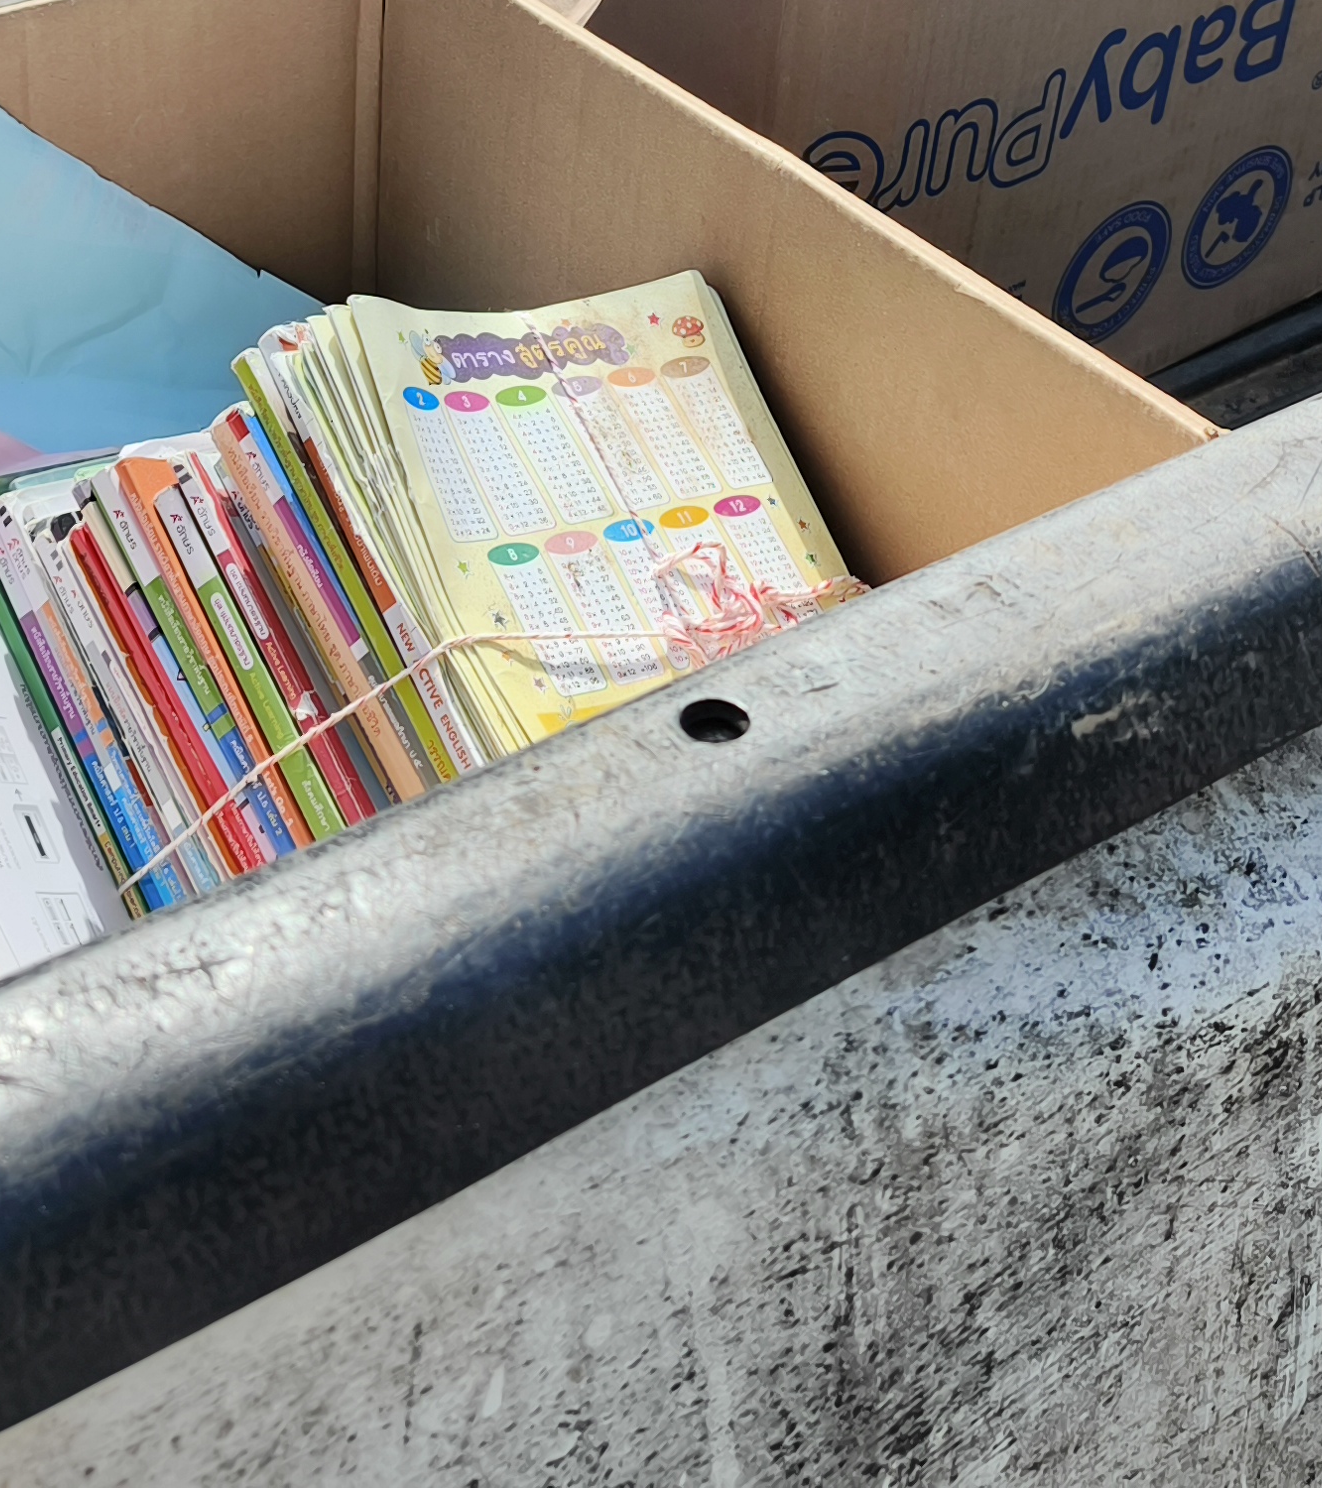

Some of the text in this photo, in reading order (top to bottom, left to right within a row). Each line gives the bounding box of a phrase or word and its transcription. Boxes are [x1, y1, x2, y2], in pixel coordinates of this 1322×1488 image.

[416, 392, 427, 406] 2
[461, 393, 472, 409] 3
[517, 390, 527, 402] 4
[627, 371, 636, 384] 6
[679, 362, 688, 373] 7
[196, 505, 219, 538] อักษร
[264, 641, 282, 666] Active
[226, 446, 267, 511] หนังสือเรียน
[299, 591, 337, 643] ภาษาไทย
[507, 499, 747, 561] 8 9 10 11 12
[118, 519, 140, 551] อักษร
[274, 827, 284, 837] 2
[175, 523, 198, 556] อักษร
[248, 671, 267, 700] Active
[263, 701, 285, 741] Learning
[395, 622, 415, 652] NEW
[439, 714, 472, 770] ENGLISH
[55, 736, 74, 766] Primary
[69, 765, 90, 802] Education
